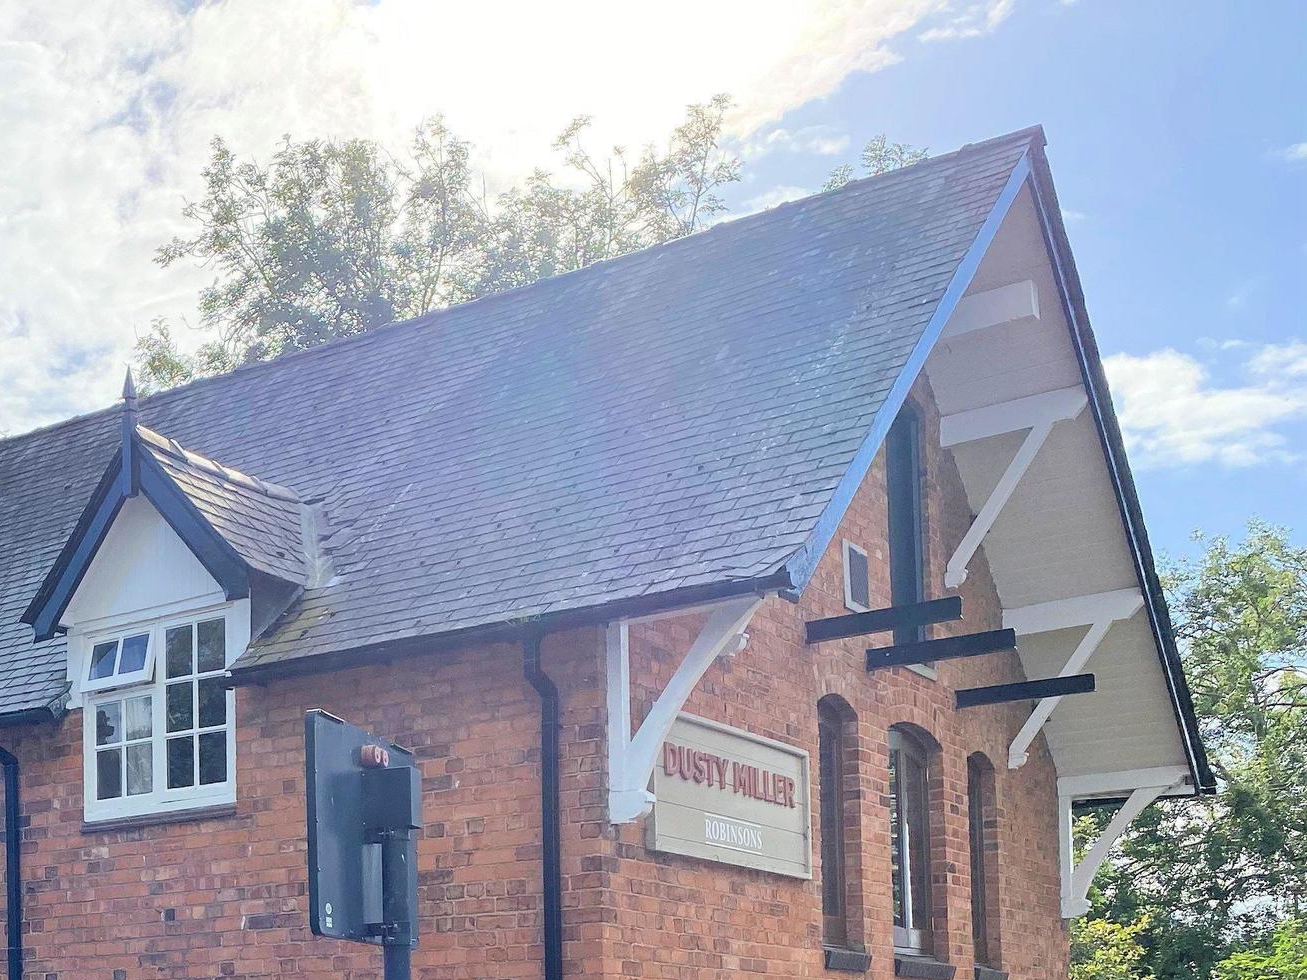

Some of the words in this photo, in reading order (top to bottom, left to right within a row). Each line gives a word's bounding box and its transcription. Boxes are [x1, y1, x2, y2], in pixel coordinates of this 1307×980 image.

[663, 741, 729, 790] DUSTY
[733, 762, 796, 809] MILLER
[705, 819, 763, 850] ROBINSONS
